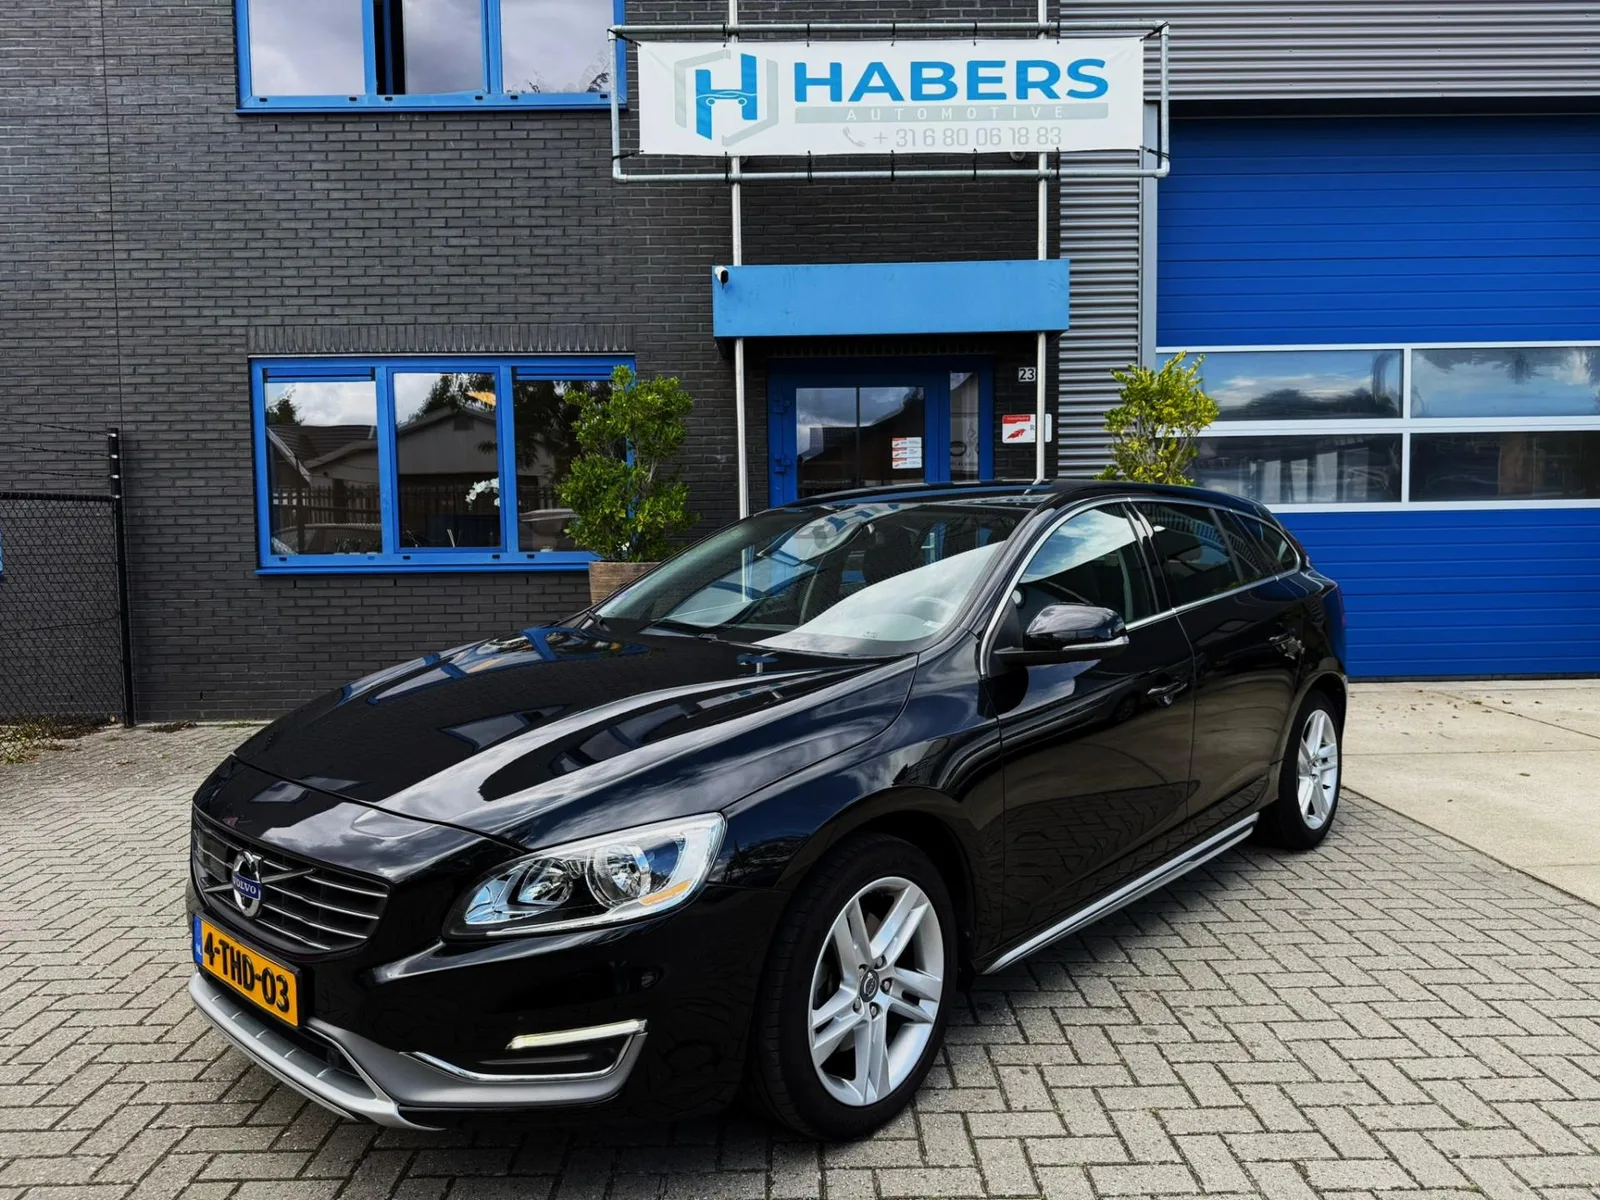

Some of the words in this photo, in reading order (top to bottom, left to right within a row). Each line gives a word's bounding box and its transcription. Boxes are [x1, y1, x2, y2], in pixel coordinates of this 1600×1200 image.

[794, 58, 1109, 102] HABERS
[846, 105, 1064, 121] AUTOMOTIVE
[895, 128, 916, 147] 31
[923, 128, 936, 147] 6
[943, 127, 968, 146] 80
[976, 127, 1002, 146] 06
[1008, 126, 1029, 145] 18
[1036, 126, 1062, 145] 83
[1019, 368, 1035, 380] 23
[232, 876, 257, 895] VOLVO
[204, 932, 290, 1013] 4-THD-03
